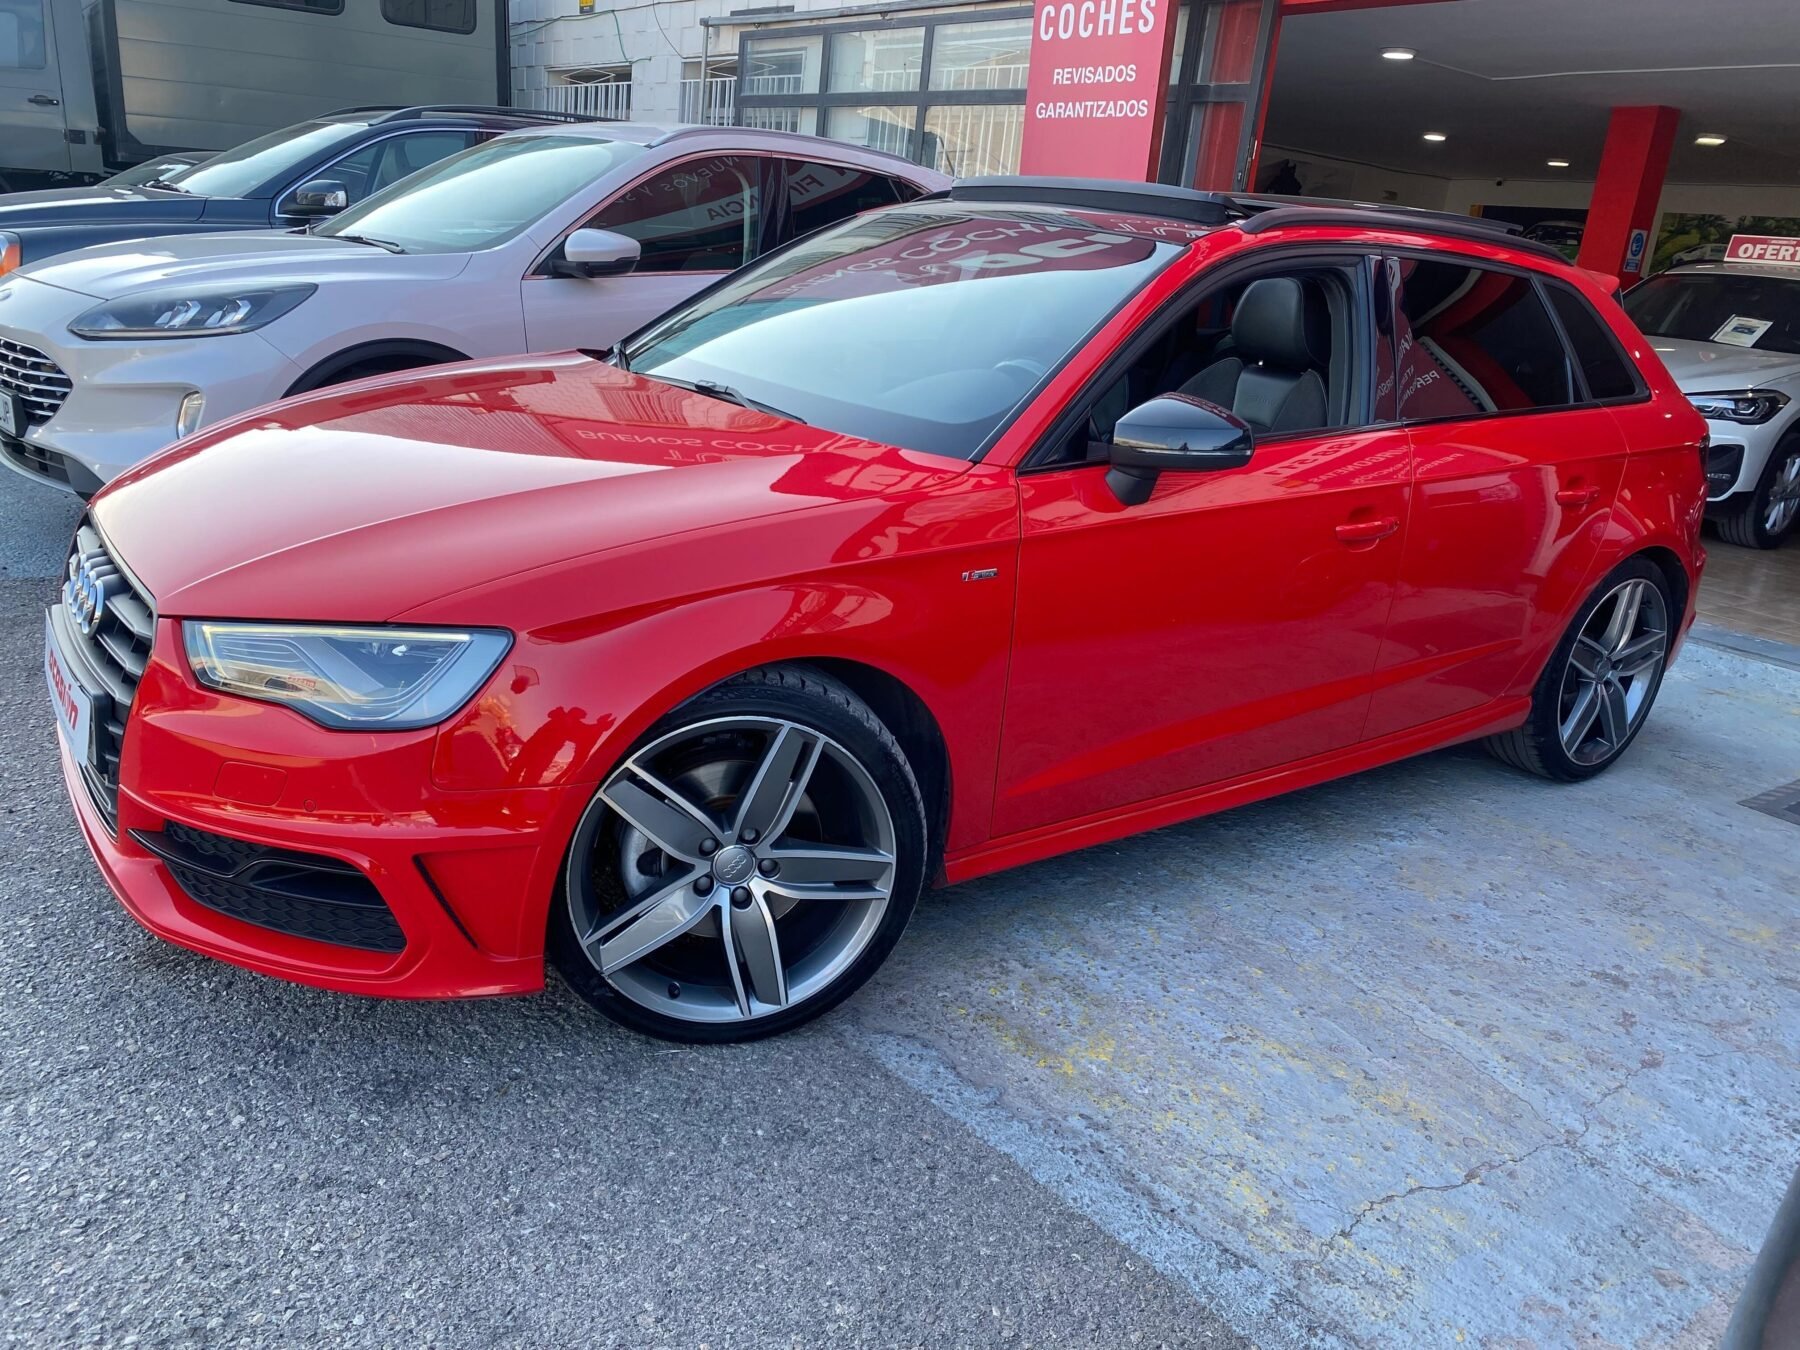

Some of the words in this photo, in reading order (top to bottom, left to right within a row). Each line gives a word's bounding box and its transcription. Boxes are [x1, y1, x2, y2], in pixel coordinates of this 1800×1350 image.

[1039, 0, 1156, 41] COCHES
[1052, 64, 1137, 85] REVISADOS
[1035, 99, 1149, 119] GARANTIZADOS
